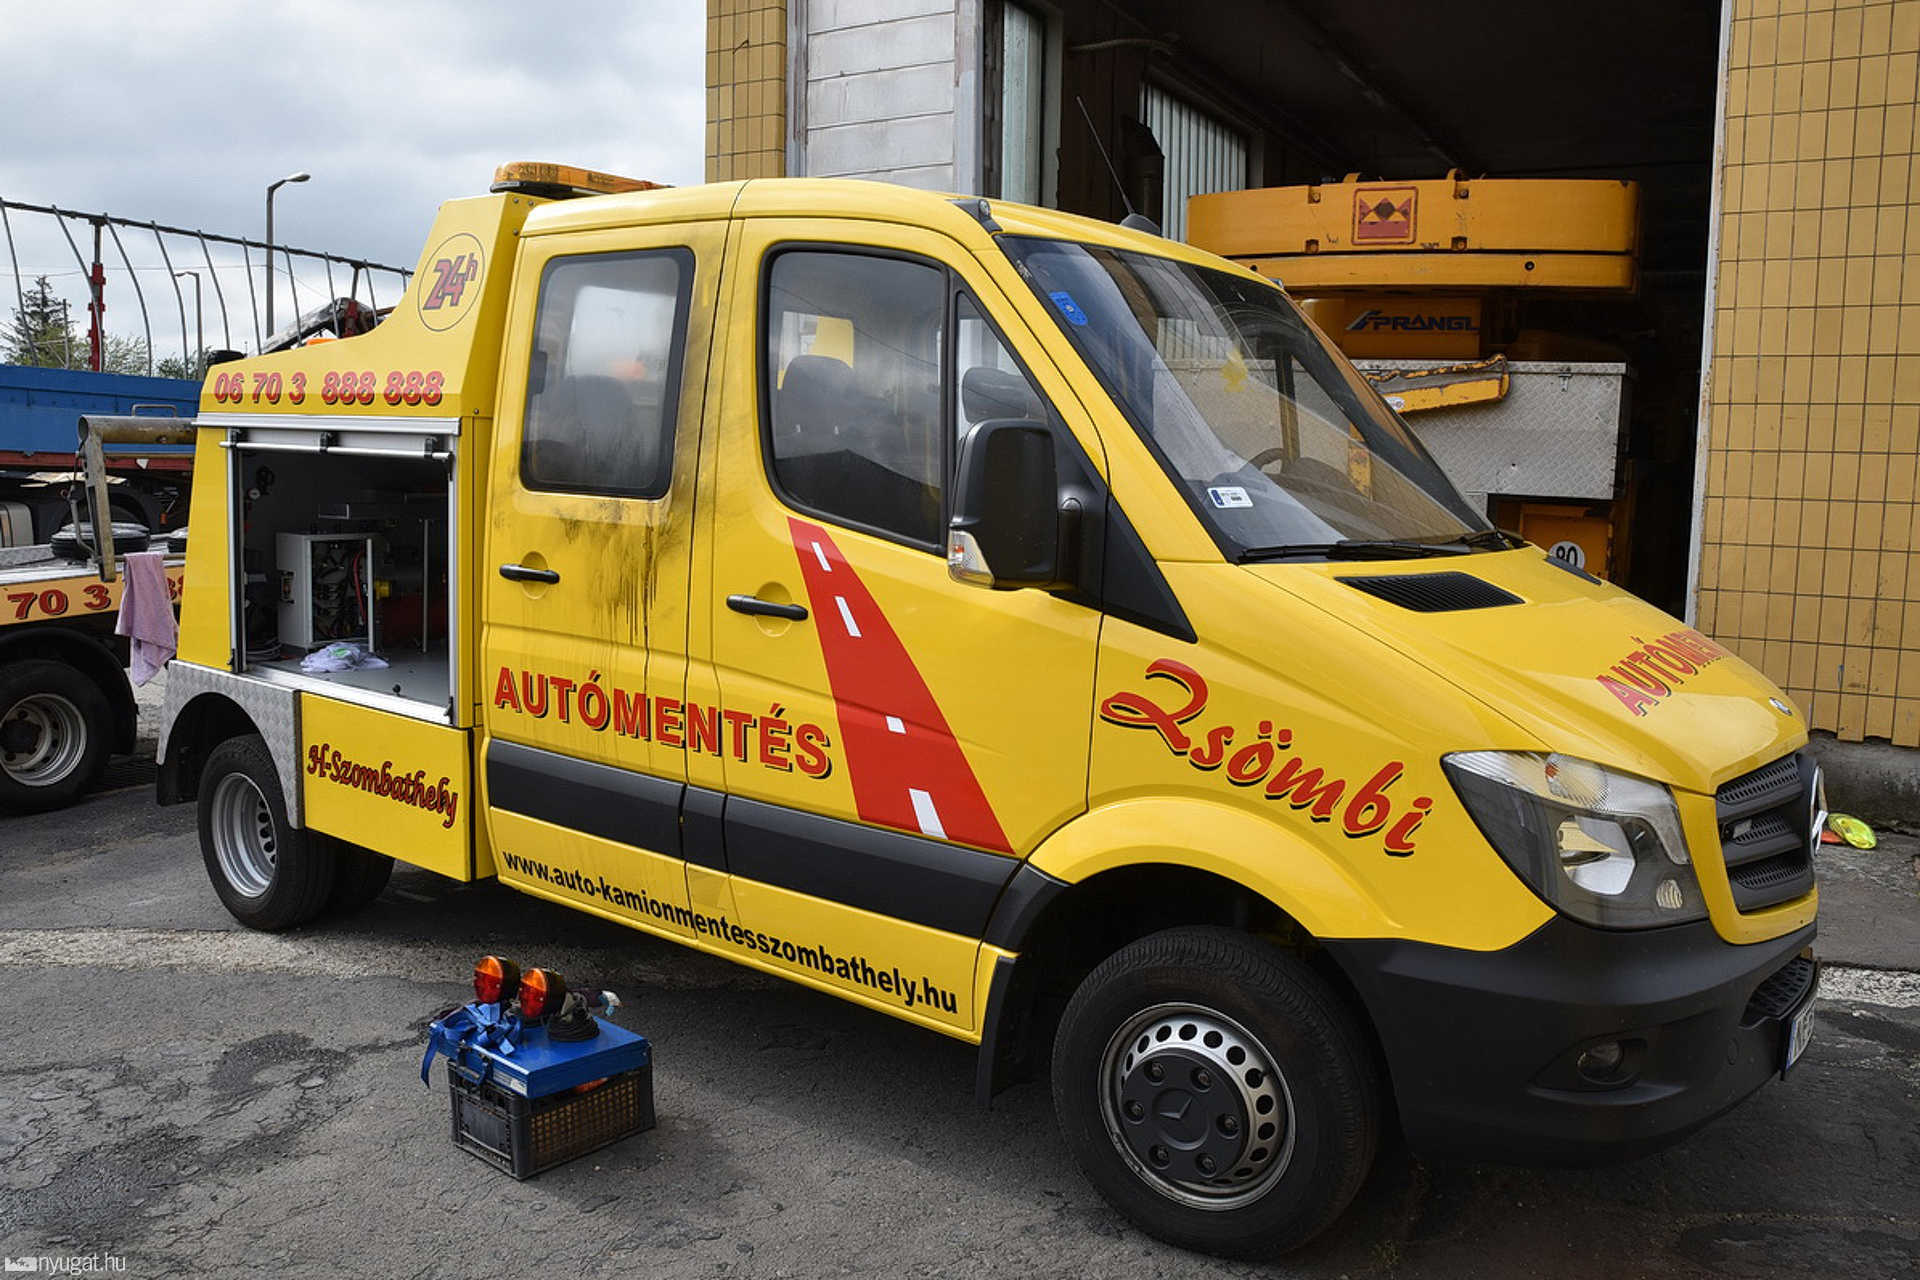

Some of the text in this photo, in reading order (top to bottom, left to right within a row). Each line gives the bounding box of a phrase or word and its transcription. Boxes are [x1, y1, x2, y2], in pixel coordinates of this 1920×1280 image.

[422, 252, 478, 310] 24h
[214, 371, 444, 406] 06 70 3 888 888
[7, 584, 111, 619] 70 3
[494, 666, 833, 779] AUTÓMENTÉS
[306, 743, 459, 829] H-Szombathely
[502, 850, 958, 1014] www.auto-kamionmentesszombathely.hu
